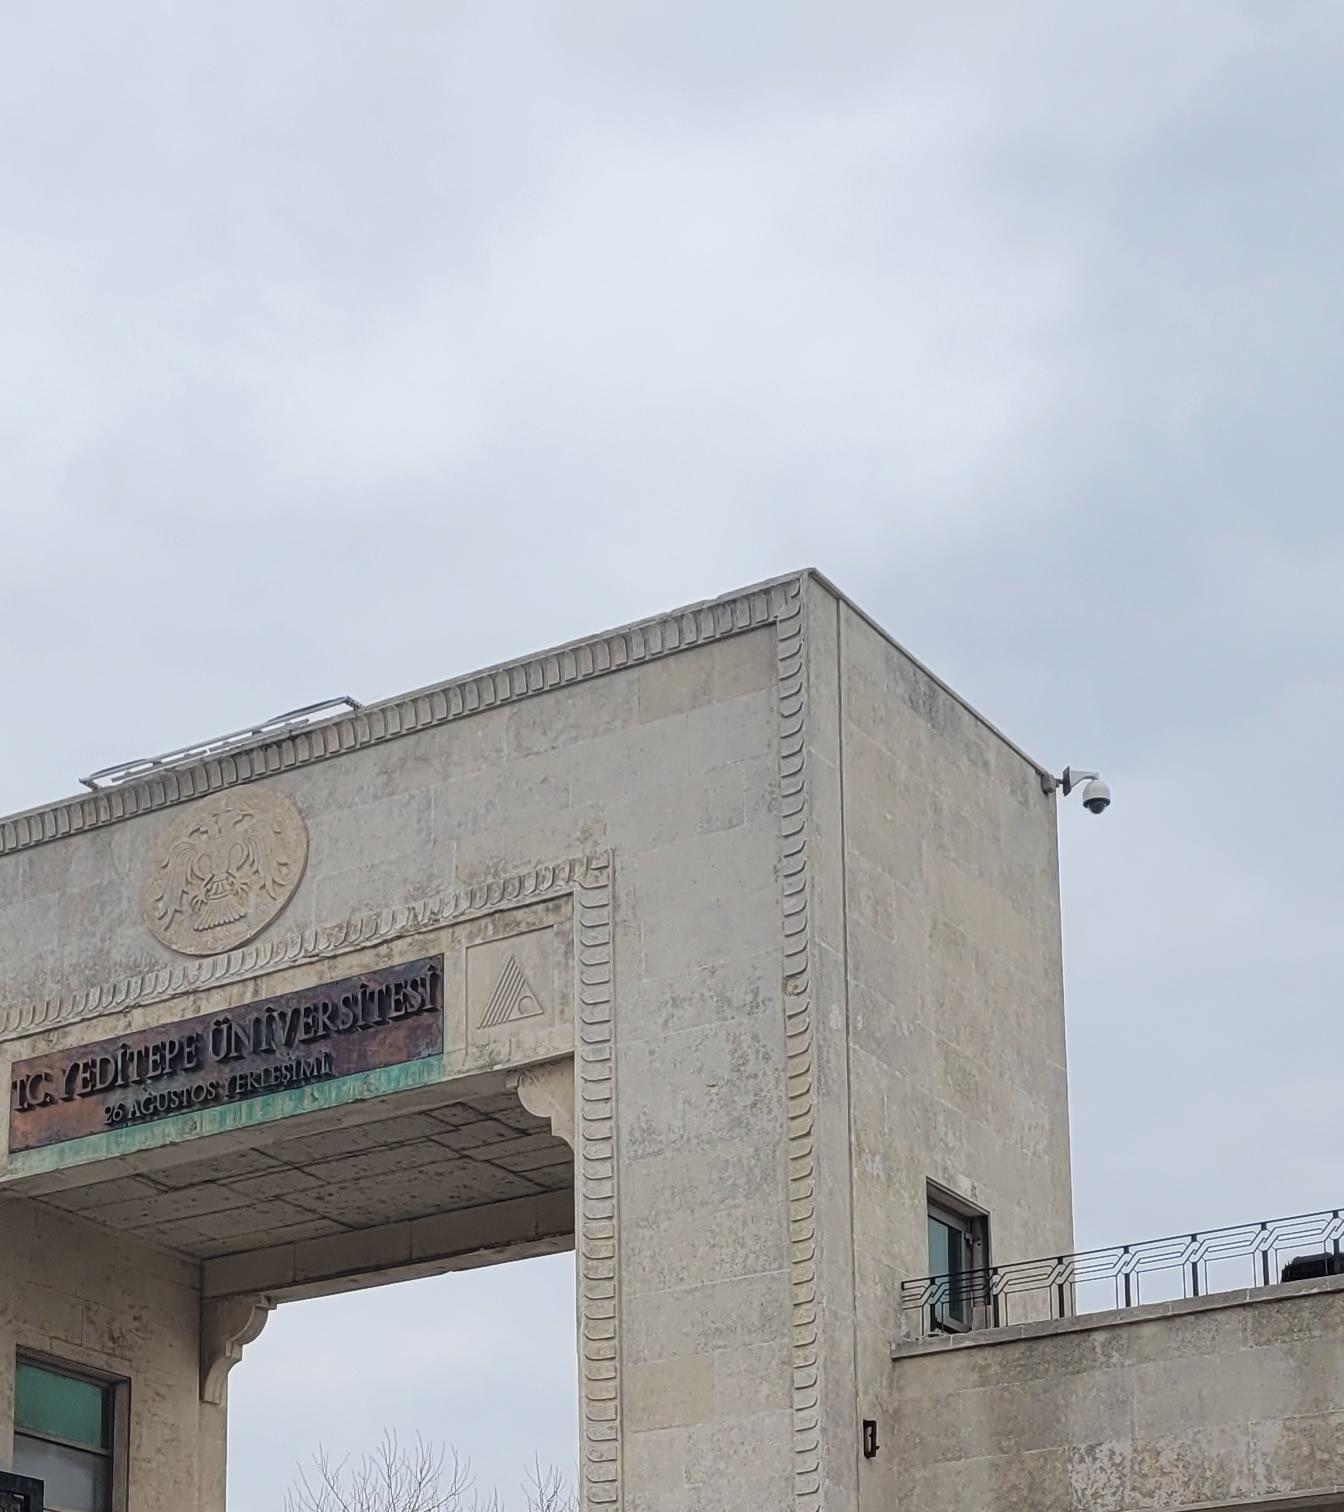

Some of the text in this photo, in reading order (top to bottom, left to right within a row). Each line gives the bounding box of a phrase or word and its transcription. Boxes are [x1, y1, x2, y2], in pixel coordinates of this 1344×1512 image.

[62, 1034, 199, 1100] YEDİTEPE
[209, 964, 441, 1061] ÜNİVERSİTESİ
[104, 1051, 331, 1124] 26 AĞUSTOS YERLEŞİMİ
